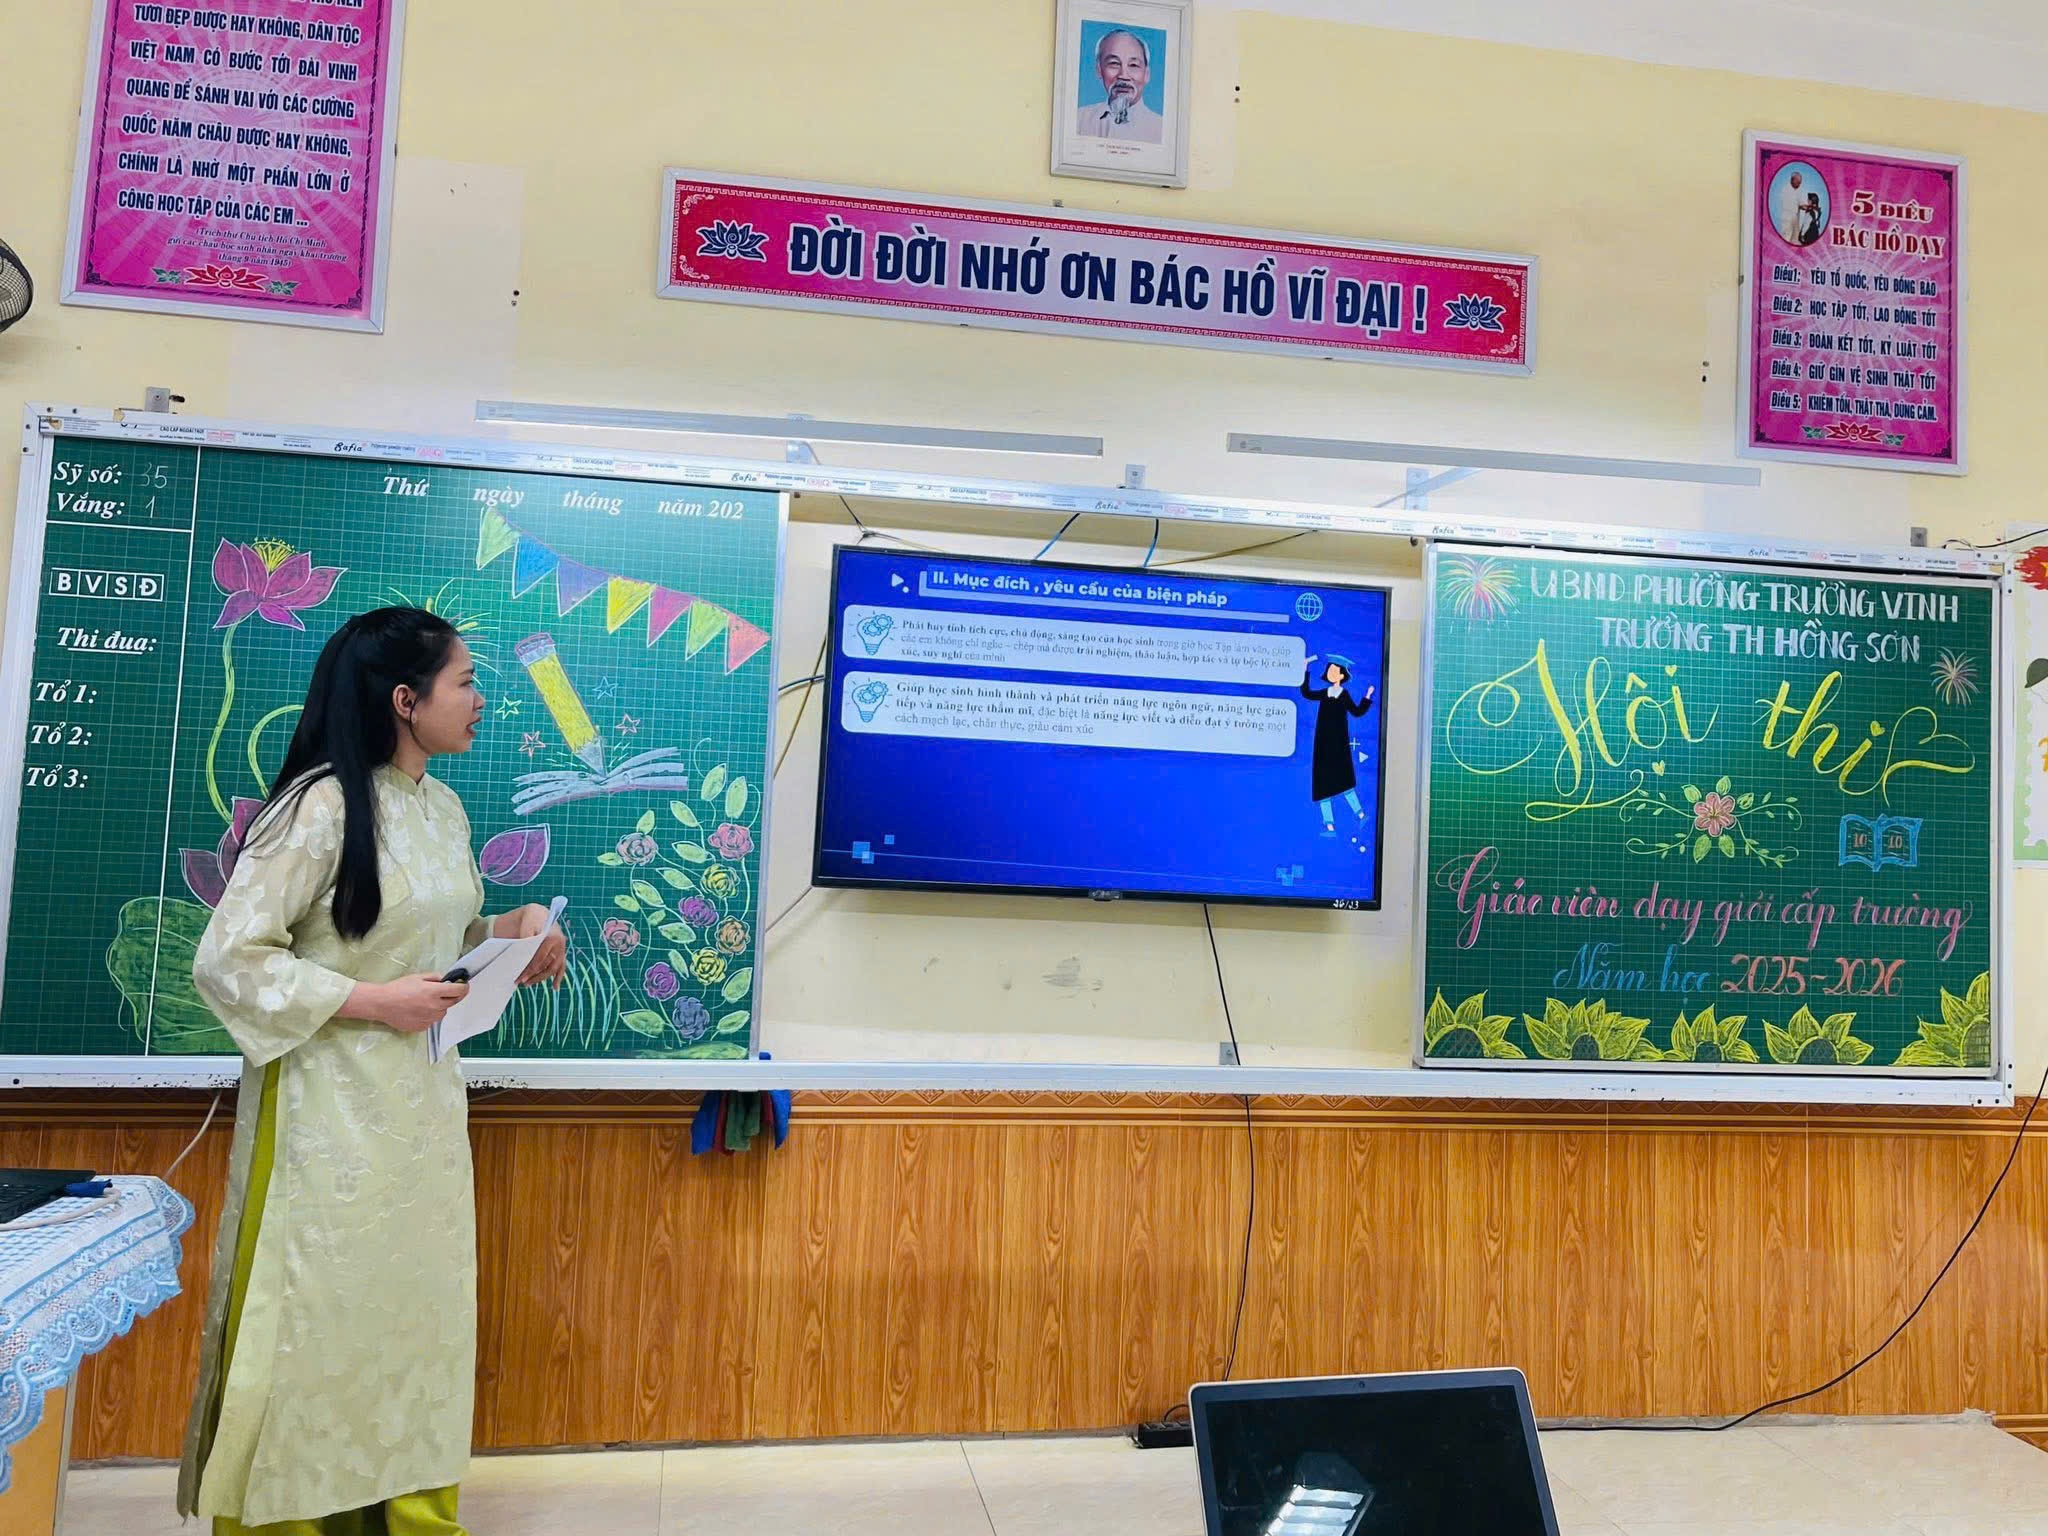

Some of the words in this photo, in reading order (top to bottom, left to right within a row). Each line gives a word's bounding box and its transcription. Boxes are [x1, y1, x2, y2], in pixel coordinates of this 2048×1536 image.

[135, 5, 162, 23] TƯƠI
[166, 7, 190, 28] ĐẸP
[194, 10, 227, 31] ĐƯỢC
[231, 15, 255, 32] HAY
[258, 17, 303, 40] KHÔNG,
[307, 22, 333, 41] DÂN
[337, 24, 359, 46] TỘC
[131, 41, 157, 61] VIỆT
[165, 45, 195, 64] NAM
[204, 46, 220, 66] CÓ
[229, 51, 262, 71] BƯỚC
[272, 53, 290, 74] TỚI
[298, 57, 320, 76] ĐÀI
[328, 62, 357, 81] VINH
[126, 78, 170, 98] QUANG
[174, 78, 190, 100] ĐỂ
[194, 82, 229, 104] SÁNH
[234, 90, 254, 106] VAI
[258, 88, 278, 109] VỚI
[283, 91, 307, 113] CÁC
[312, 96, 354, 118] CƯỜNG
[122, 113, 156, 134] QUỐC
[162, 117, 192, 138] NĂM
[197, 121, 230, 141] CHÂU
[236, 127, 270, 148] ĐƯỢC
[276, 132, 300, 149] HAY
[305, 132, 351, 156] KHÔNG,
[118, 152, 158, 172] CHÍNH
[167, 156, 182, 176] LÀ
[192, 159, 218, 179] NHỜ
[227, 161, 254, 183] MỘT
[264, 163, 298, 187] PHẦN
[307, 171, 332, 191] LỚN
[340, 171, 350, 192] Ở
[118, 189, 154, 209] CÔNG
[158, 194, 183, 214] HỌC
[188, 195, 212, 217] TẬP
[215, 196, 241, 219] CỦA
[244, 202, 270, 222] CÁC
[274, 208, 293, 225] EM
[1853, 192, 1874, 214] 5
[1880, 200, 1932, 222] ĐIỀU
[1832, 224, 1870, 248] BÁC
[1874, 226, 1900, 251] HỒ
[1906, 236, 1944, 260] DẠY
[790, 214, 861, 277] ĐỜI
[876, 224, 947, 286] ĐỜI
[961, 236, 1050, 294] NHỚ
[1060, 250, 1115, 300] ƠN
[1130, 254, 1209, 310] BÁC
[1224, 257, 1276, 316] HỒ
[1288, 269, 1326, 322] VĨ
[1336, 280, 1399, 336] ĐẠI
[1414, 287, 1426, 331] !
[1810, 267, 1826, 285] YÊU
[1831, 267, 1840, 286] TỔ
[1844, 270, 1869, 290] QUỐC,
[1874, 275, 1889, 291] YÊU
[1893, 275, 1915, 294] ĐỒNG
[1920, 280, 1936, 296] BÀO
[1773, 296, 1792, 312] Điều
[1794, 299, 1802, 314] 2:
[1810, 300, 1826, 318] HỌC
[1832, 301, 1847, 320] TẬP
[1852, 300, 1869, 322] TỐT,
[1874, 306, 1889, 322] LAO
[1894, 307, 1916, 326] ĐỘNG
[1922, 308, 1936, 327] TỐT
[1772, 329, 1792, 346] Điều
[1794, 332, 1802, 346] 3:
[1810, 332, 1832, 349] ĐOÀN
[1838, 332, 1852, 351] KẾT
[1858, 333, 1876, 355] TỐT,
[1880, 335, 1891, 354] KỶ
[1896, 341, 1917, 362] LUẬT
[1922, 341, 1936, 360] TỐT
[1772, 358, 1792, 376] Điều
[1793, 362, 1801, 376] 4:
[1809, 363, 1825, 380] GIỮ
[1830, 364, 1844, 382] GÌN
[1850, 366, 1861, 388] VỆ
[1866, 370, 1888, 386] SINH
[1894, 369, 1914, 389] THẬT
[1920, 371, 1936, 390] TỐT
[1771, 390, 1791, 408] Điều
[1792, 394, 1800, 409] 5:
[1808, 392, 1833, 411] KHIÊM
[1836, 394, 1852, 414] TỐN,
[1855, 397, 1874, 416] THẬT
[1875, 400, 1892, 418] THÀ,
[1894, 400, 1915, 420] DŨNG
[1918, 400, 1936, 420] CẢM.
[54, 461, 82, 484] Sỹ
[88, 463, 122, 484] số:
[139, 463, 169, 488] 35
[56, 492, 125, 518] Vắng:
[146, 496, 156, 518] 1
[382, 475, 430, 498] Thứ
[473, 485, 525, 507] ngày
[562, 490, 624, 516] tháng
[658, 498, 702, 518] năm
[708, 500, 744, 520] 202
[933, 572, 948, 584] II.
[954, 573, 988, 590] Mục
[994, 575, 1029, 591] đích
[1043, 577, 1074, 594] yêu
[1112, 584, 1141, 599] của
[1147, 585, 1181, 604] biện
[1186, 590, 1227, 606] pháp
[1530, 567, 1626, 602] UBND
[1634, 572, 1761, 611] PHƯỜNG
[1761, 581, 1876, 618] TRƯỜNG
[1881, 590, 1959, 624] VINH
[57, 627, 99, 649] Thi
[104, 631, 157, 652] đua:
[1594, 613, 1713, 652] TRƯỜNG
[1723, 622, 1765, 655] TH
[1774, 619, 1858, 661] HỒNG
[1865, 631, 1921, 663] SƠN
[35, 680, 70, 703] Tổ
[72, 684, 98, 704] 1:
[31, 722, 66, 745] Tổ
[67, 726, 92, 746] 2:
[26, 764, 62, 788] Tổ
[64, 768, 88, 788] 3:
[1853, 832, 1867, 848] 10
[1888, 835, 1903, 849] 10
[1436, 845, 1542, 949] Giáo
[1552, 887, 1621, 918] viên
[1633, 881, 1703, 945] dạy
[1554, 942, 1648, 992] Năm
[1660, 944, 1712, 1005] học
[1720, 953, 1905, 997] 2025-2026
